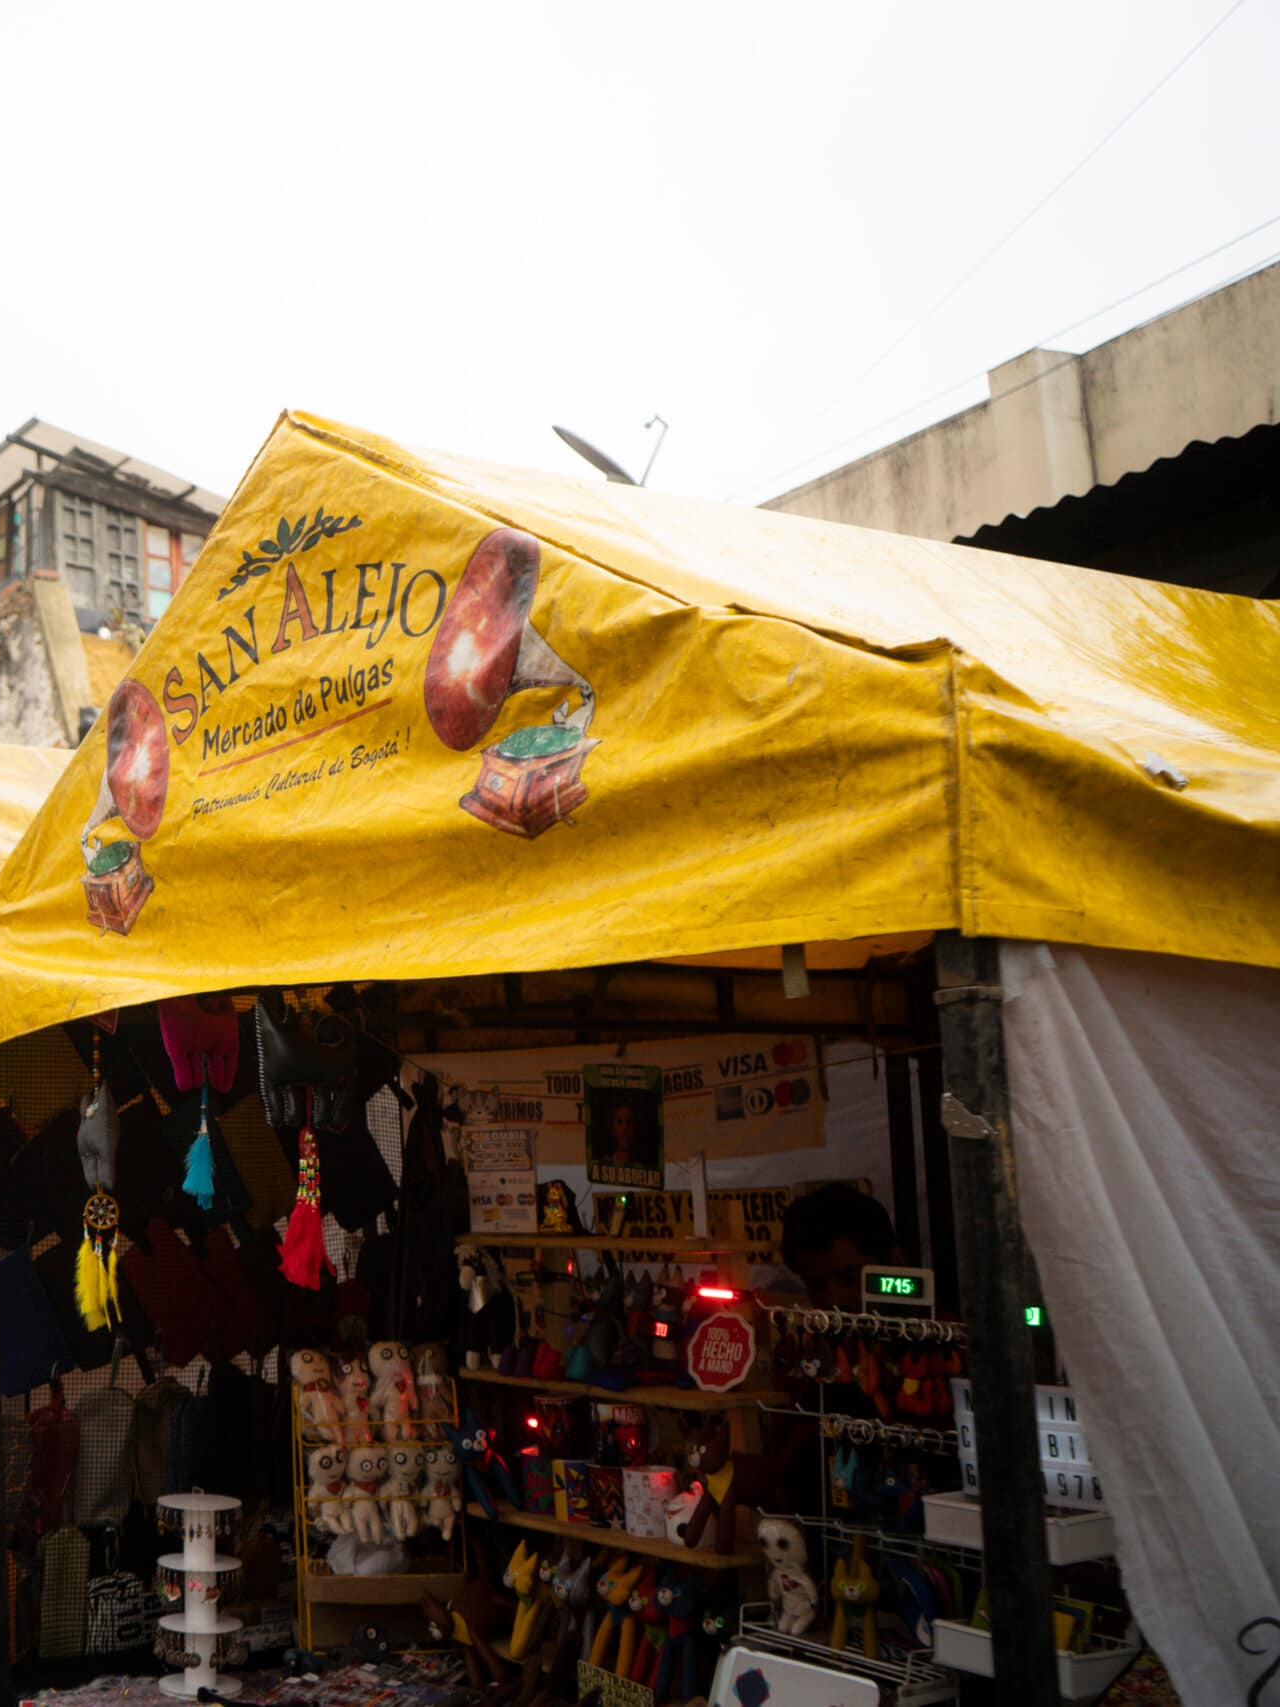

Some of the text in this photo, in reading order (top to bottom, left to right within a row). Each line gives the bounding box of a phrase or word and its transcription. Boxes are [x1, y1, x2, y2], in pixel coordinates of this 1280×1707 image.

[162, 560, 448, 746] SAN ALEJO
[202, 657, 394, 761] Mercado de Pulgas
[191, 786, 261, 820] Patrimonio
[264, 759, 326, 800] Cultural
[328, 755, 345, 778] de
[717, 1052, 768, 1077] VISA
[663, 1070, 704, 1093] AGOS
[471, 1192, 492, 1206] VISA
[707, 1327, 731, 1342] 100%
[701, 1340, 743, 1361] HECHO
[698, 1357, 734, 1375] A MANO
